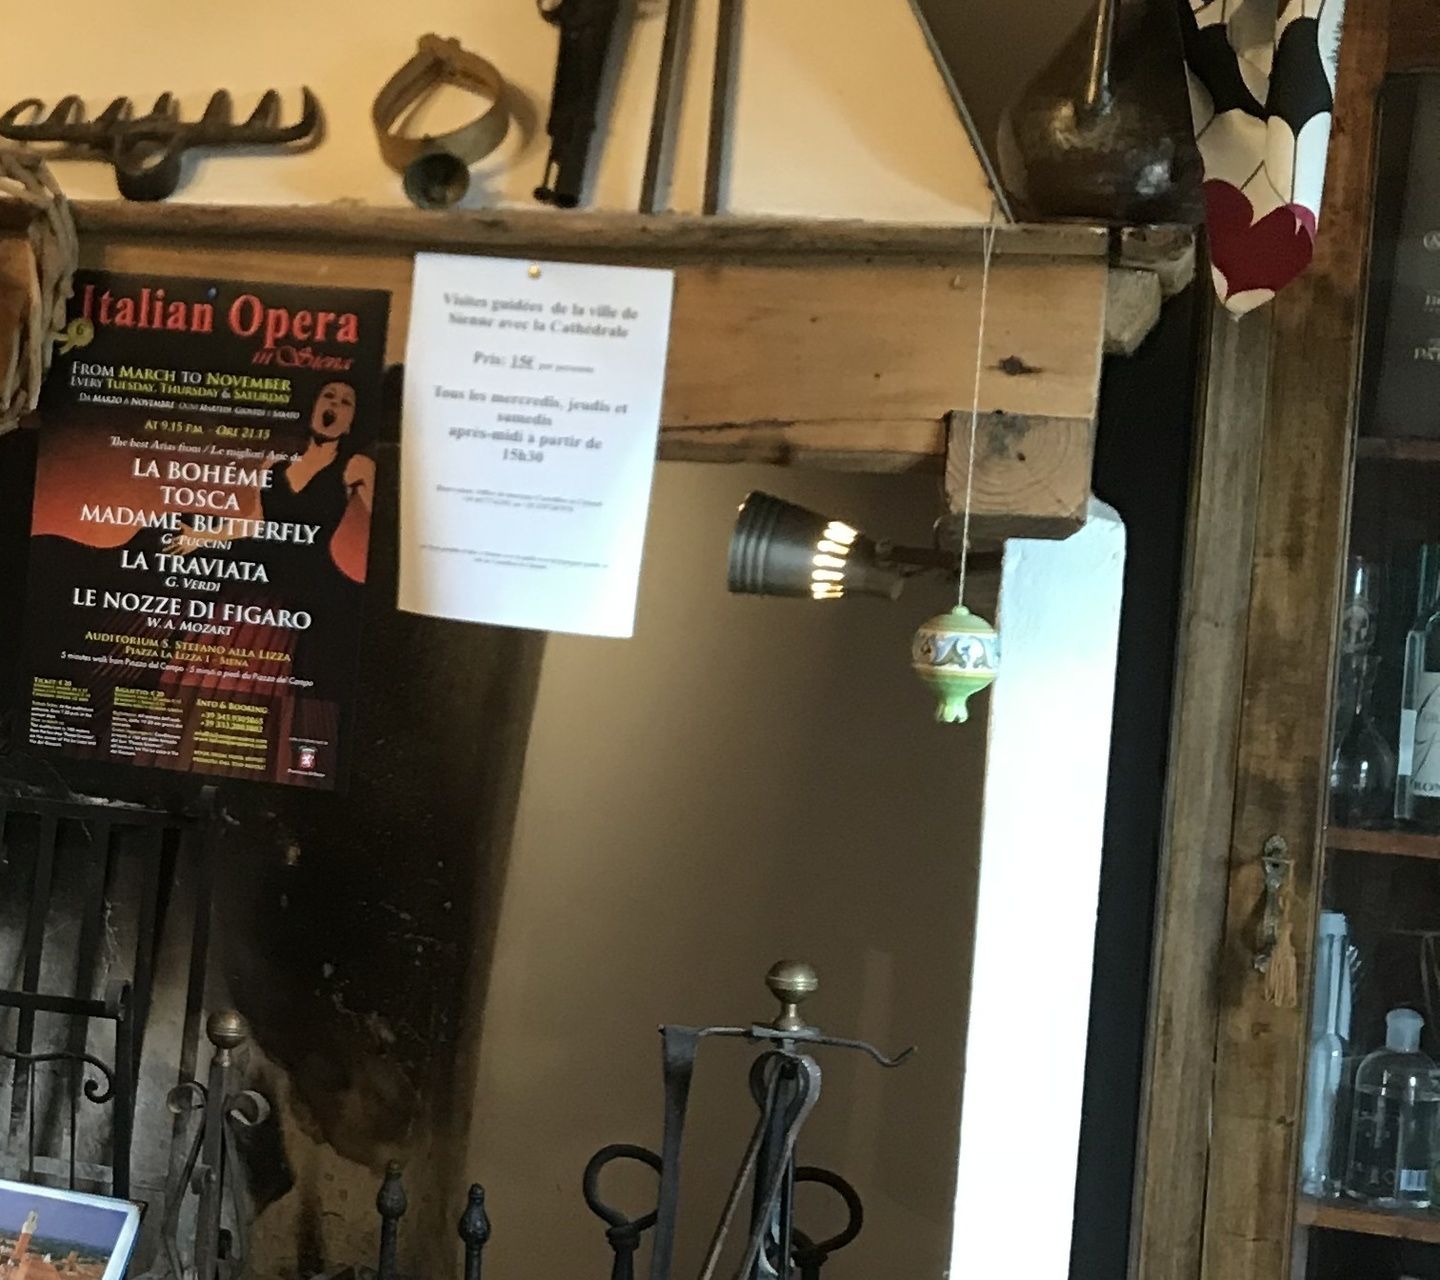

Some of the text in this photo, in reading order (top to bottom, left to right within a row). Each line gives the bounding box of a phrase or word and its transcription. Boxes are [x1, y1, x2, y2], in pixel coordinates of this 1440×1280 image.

[84, 284, 360, 351] Italian Opera
[73, 361, 292, 392] FROM MARCH TO NOVEMBER
[71, 376, 103, 389] EVERY
[161, 382, 220, 400] THURSDAY
[222, 388, 232, 400] &
[234, 389, 292, 405] SATURDAY
[145, 419, 159, 431] AT
[110, 436, 131, 448] The
[132, 438, 149, 450] best
[152, 440, 177, 452] Arias
[132, 456, 161, 479] LA
[161, 485, 242, 511] TOSCA
[81, 504, 323, 546] MADAME BUTTERFLY
[180, 535, 233, 551] PUCCINI
[121, 549, 271, 584] LA TRAVIATA
[166, 576, 222, 593] G. VERDI
[72, 587, 314, 631] LE NOZZE DI FIGARO
[180, 620, 235, 636] MOZART
[85, 630, 161, 649] AUDITORIUM
[175, 640, 226, 656] STEFANO
[229, 645, 257, 658] ALLA
[259, 647, 293, 663] LIZZA
[125, 645, 160, 658] PIAZZA
[161, 649, 174, 659] LA
[175, 651, 203, 663] LIZZA
